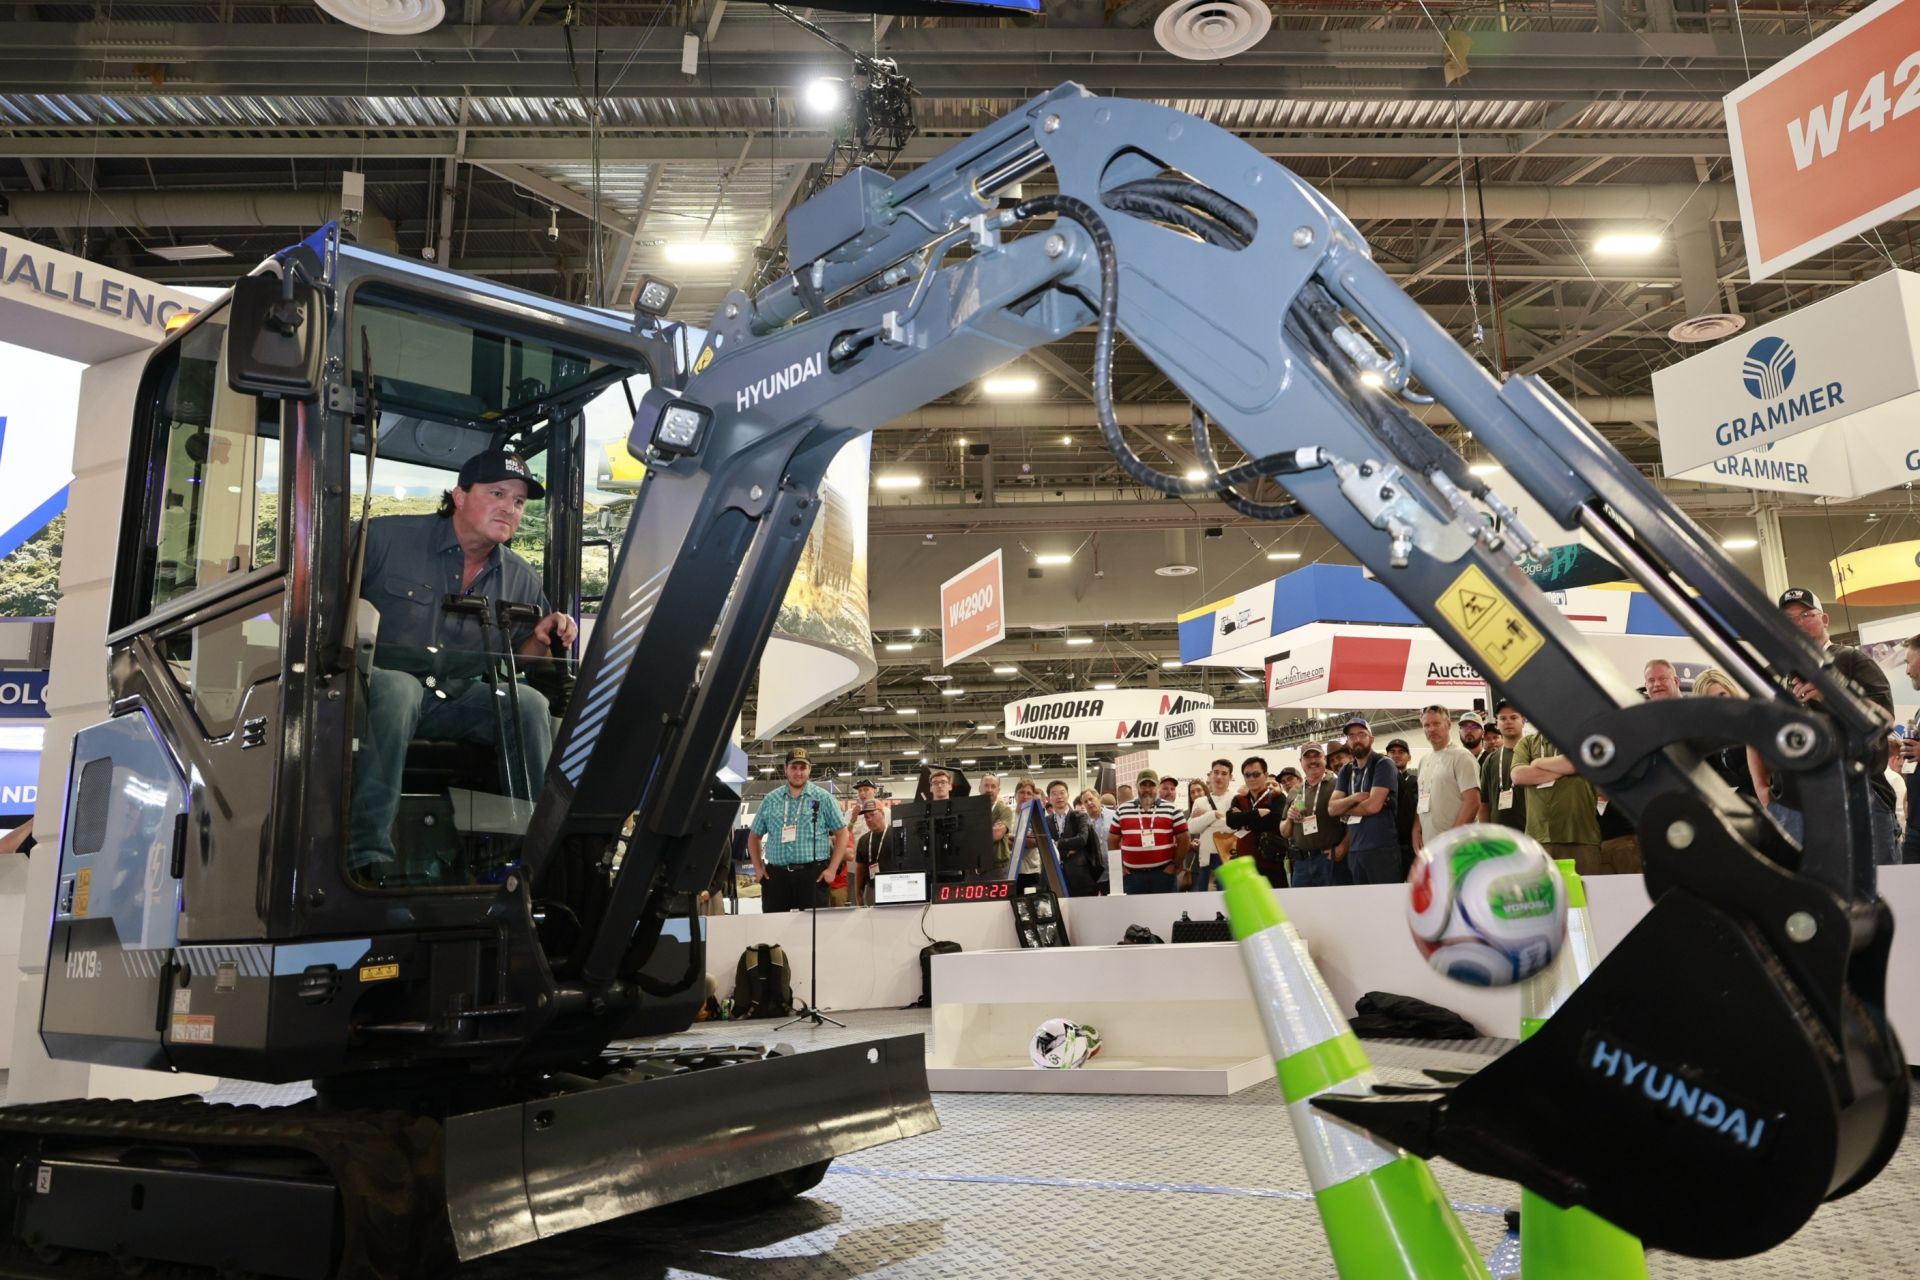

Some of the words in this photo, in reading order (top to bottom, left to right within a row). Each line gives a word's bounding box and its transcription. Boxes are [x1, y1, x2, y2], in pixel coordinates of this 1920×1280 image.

[736, 351, 823, 413] HYUNDAI
[1715, 381, 1845, 447] GRAMMER
[949, 584, 993, 628] W42900
[1165, 721, 1194, 739] KENCO
[1212, 720, 1256, 733] KENCO
[1591, 1040, 1765, 1149] HYUNDAI
